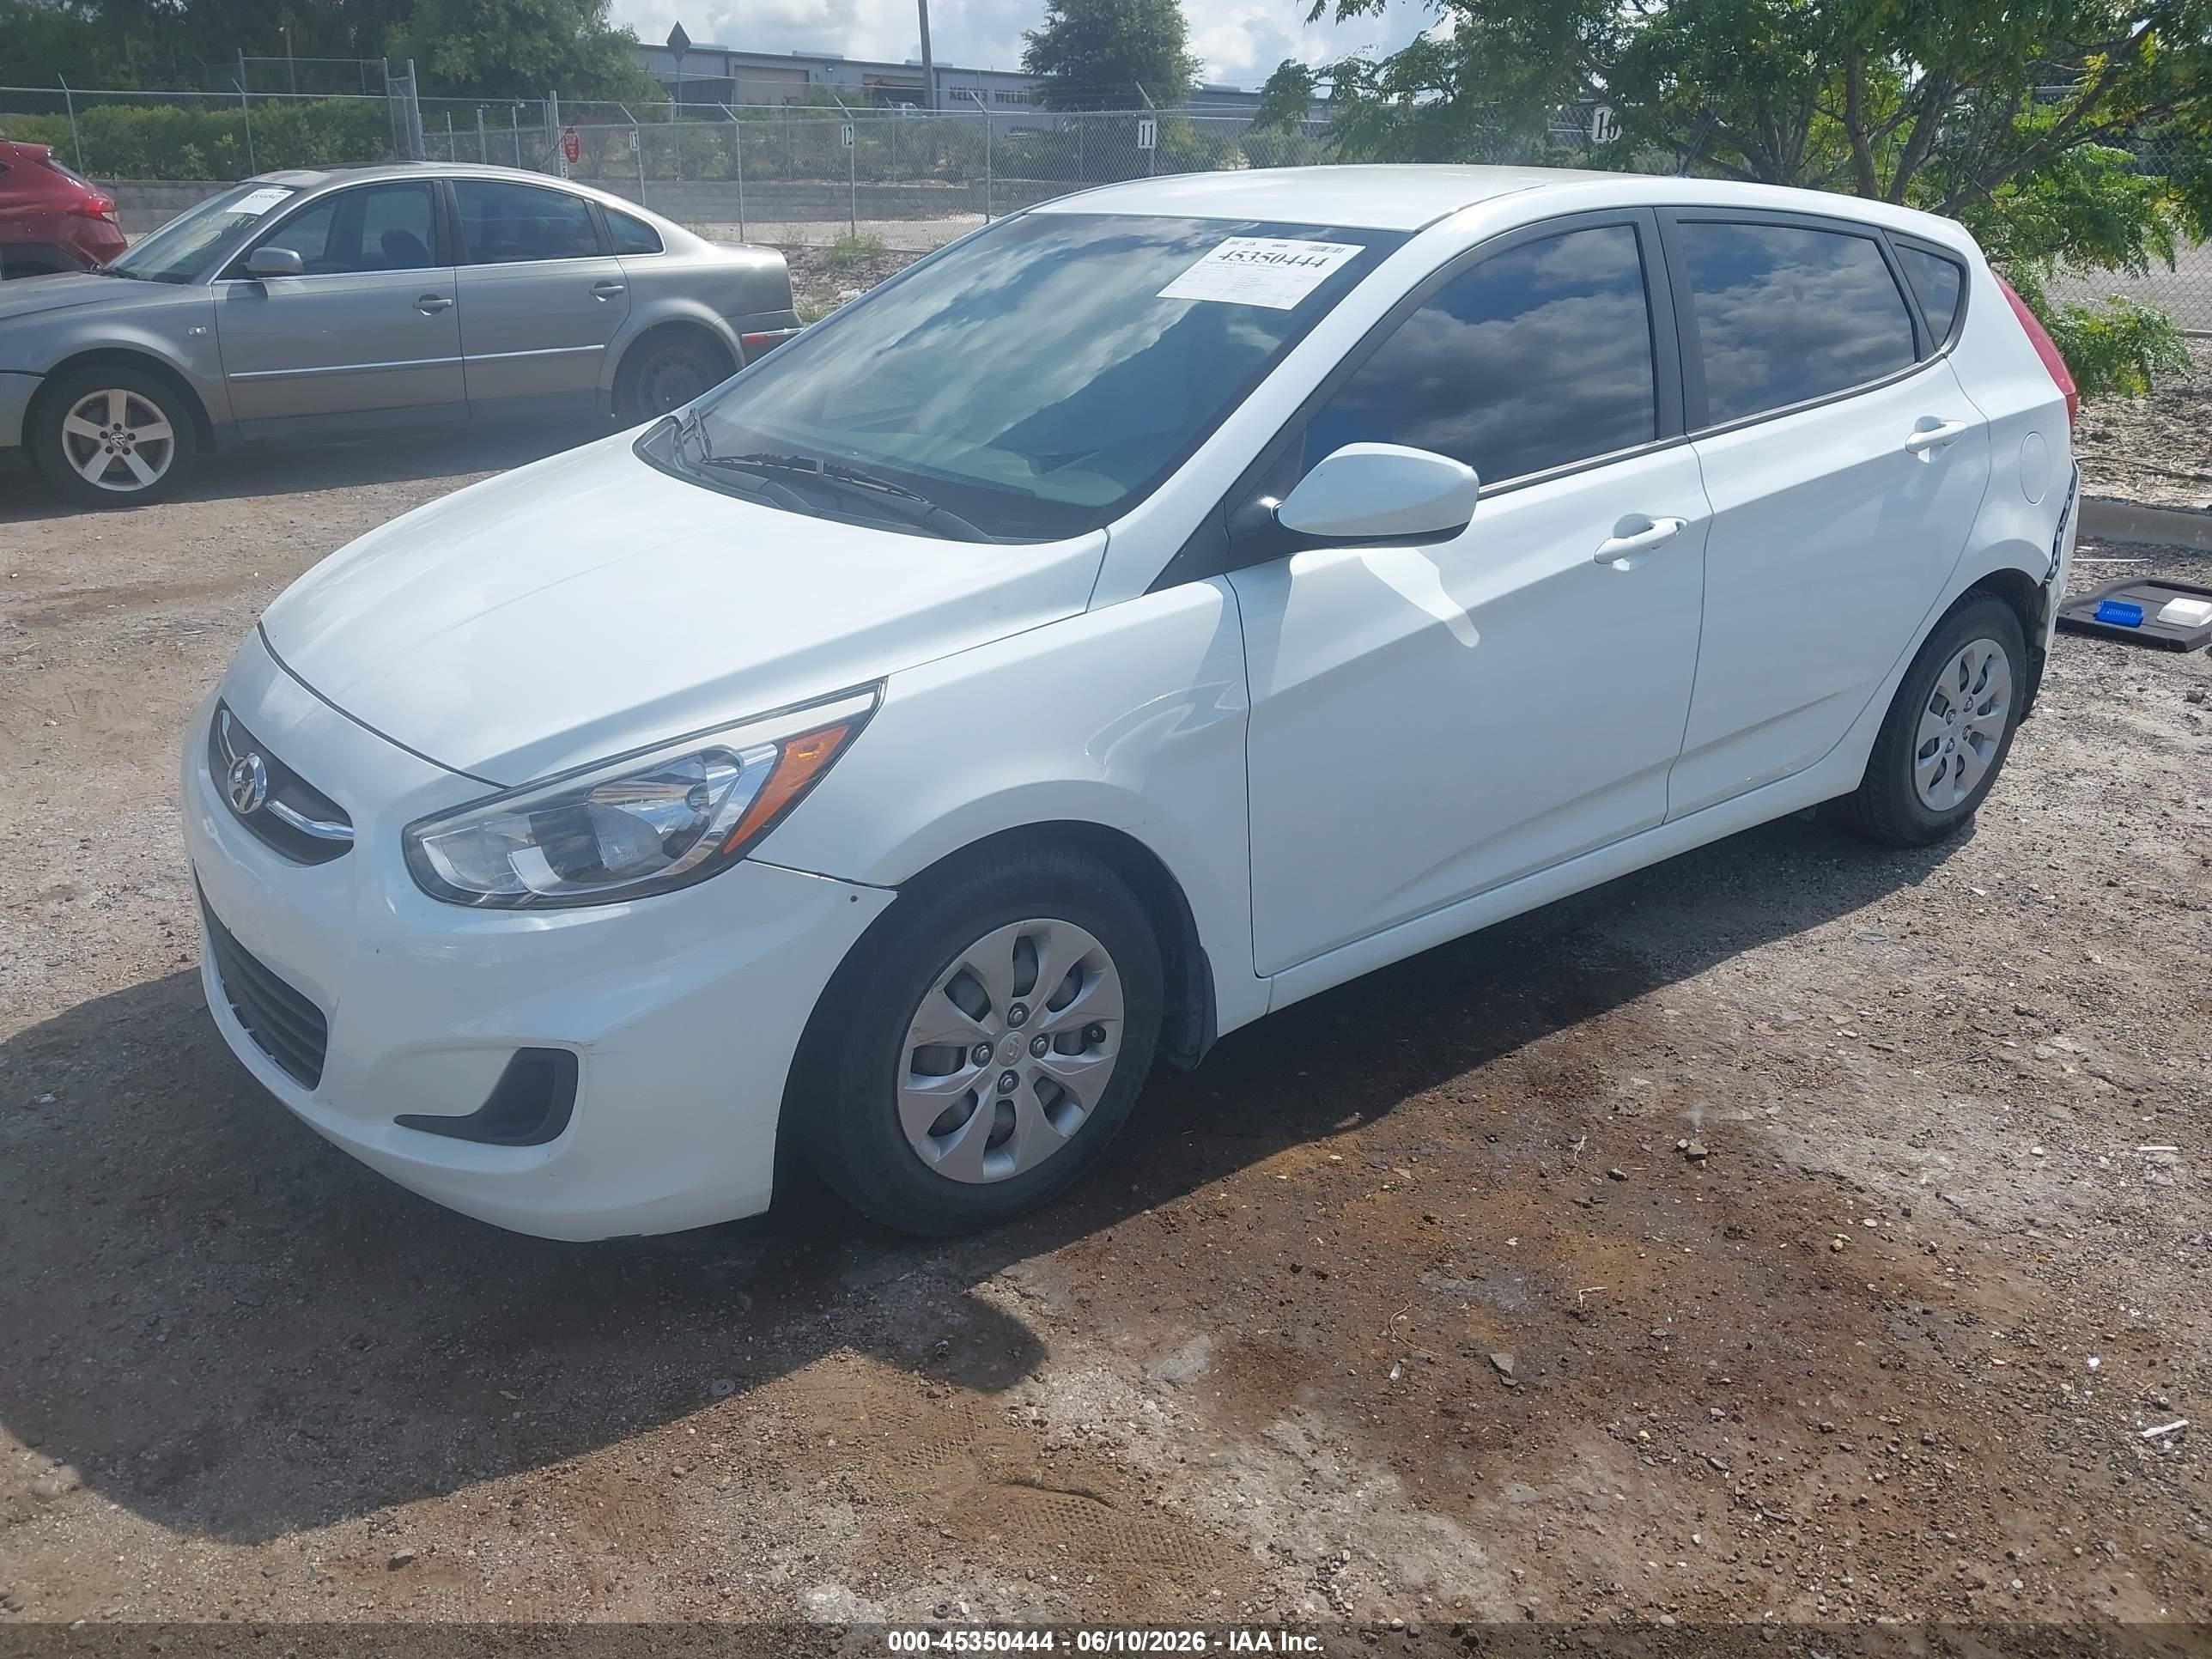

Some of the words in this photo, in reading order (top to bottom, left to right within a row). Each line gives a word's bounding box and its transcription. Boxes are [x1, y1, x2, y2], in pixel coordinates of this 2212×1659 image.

[843, 126, 853, 145] 12
[1140, 123, 1154, 146] 11
[1218, 249, 1330, 268] 45350444
